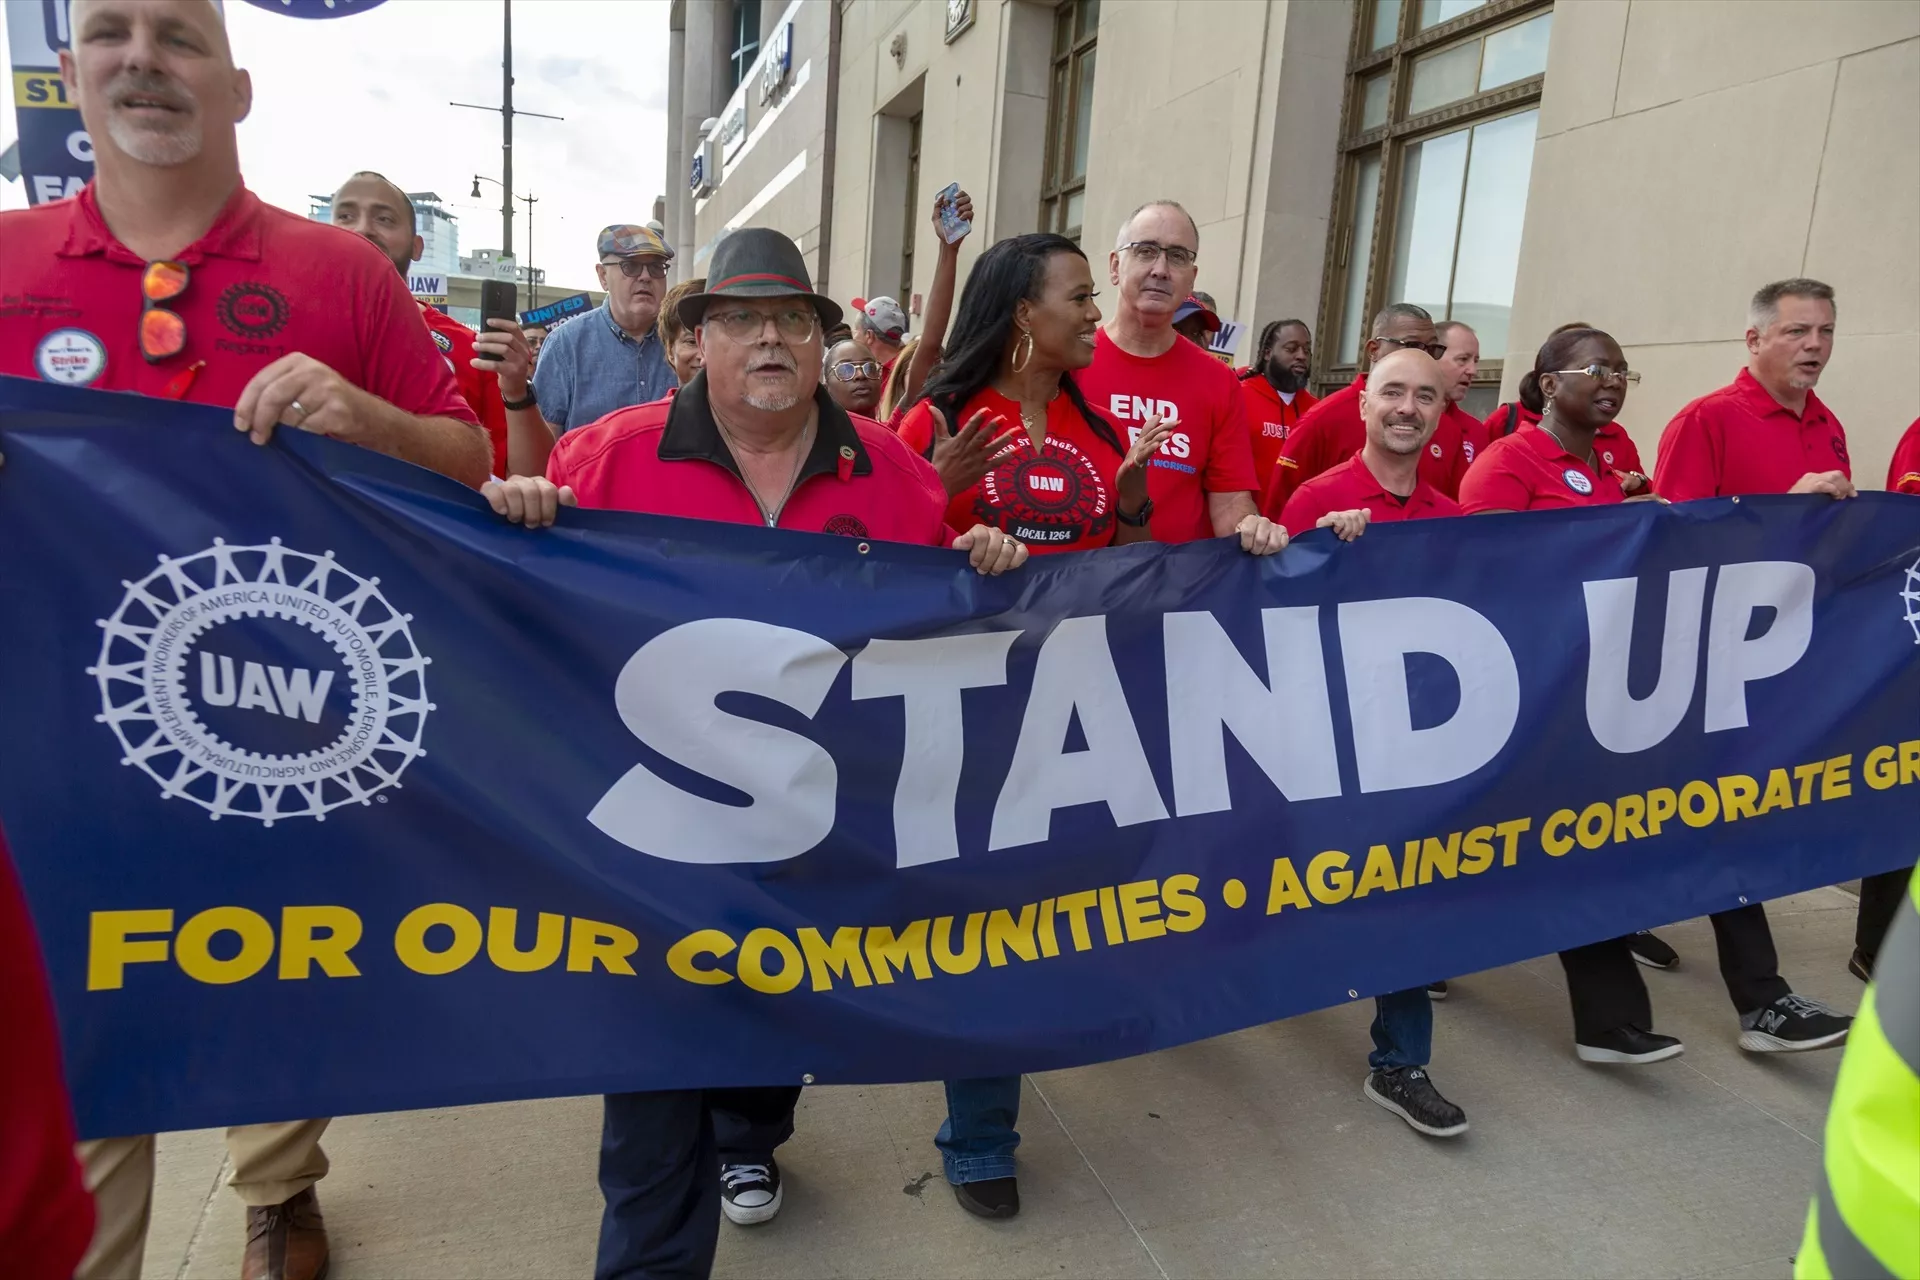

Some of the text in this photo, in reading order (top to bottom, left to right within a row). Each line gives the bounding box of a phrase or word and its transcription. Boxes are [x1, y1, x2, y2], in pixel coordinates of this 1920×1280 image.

[526, 296, 585, 323] UNITED
[51, 356, 90, 365] Strike
[1110, 394, 1178, 424] END
[984, 471, 1000, 504] LABOR
[1017, 437, 1078, 455] STONGER
[1080, 455, 1101, 483] THAN
[1095, 486, 1107, 515] EVER
[1153, 458, 1196, 475] WORKERS
[1029, 475, 1064, 492] UAW
[1015, 526, 1071, 541] LOCAL 1264
[151, 590, 380, 779] UNITED AUTOMOBILE, AEROSPACE AND AGRICULTURAL IMPLEMENT WORKERS OF AMERICA
[199, 650, 335, 724] UAW
[585, 560, 1817, 869] STAND UP
[86, 905, 363, 992] FOR
[394, 902, 640, 977] OUR
[666, 873, 1207, 995] COMMUNITIES
[1265, 816, 1532, 917] AGAINST
[1540, 753, 1853, 858] CORPORATE
